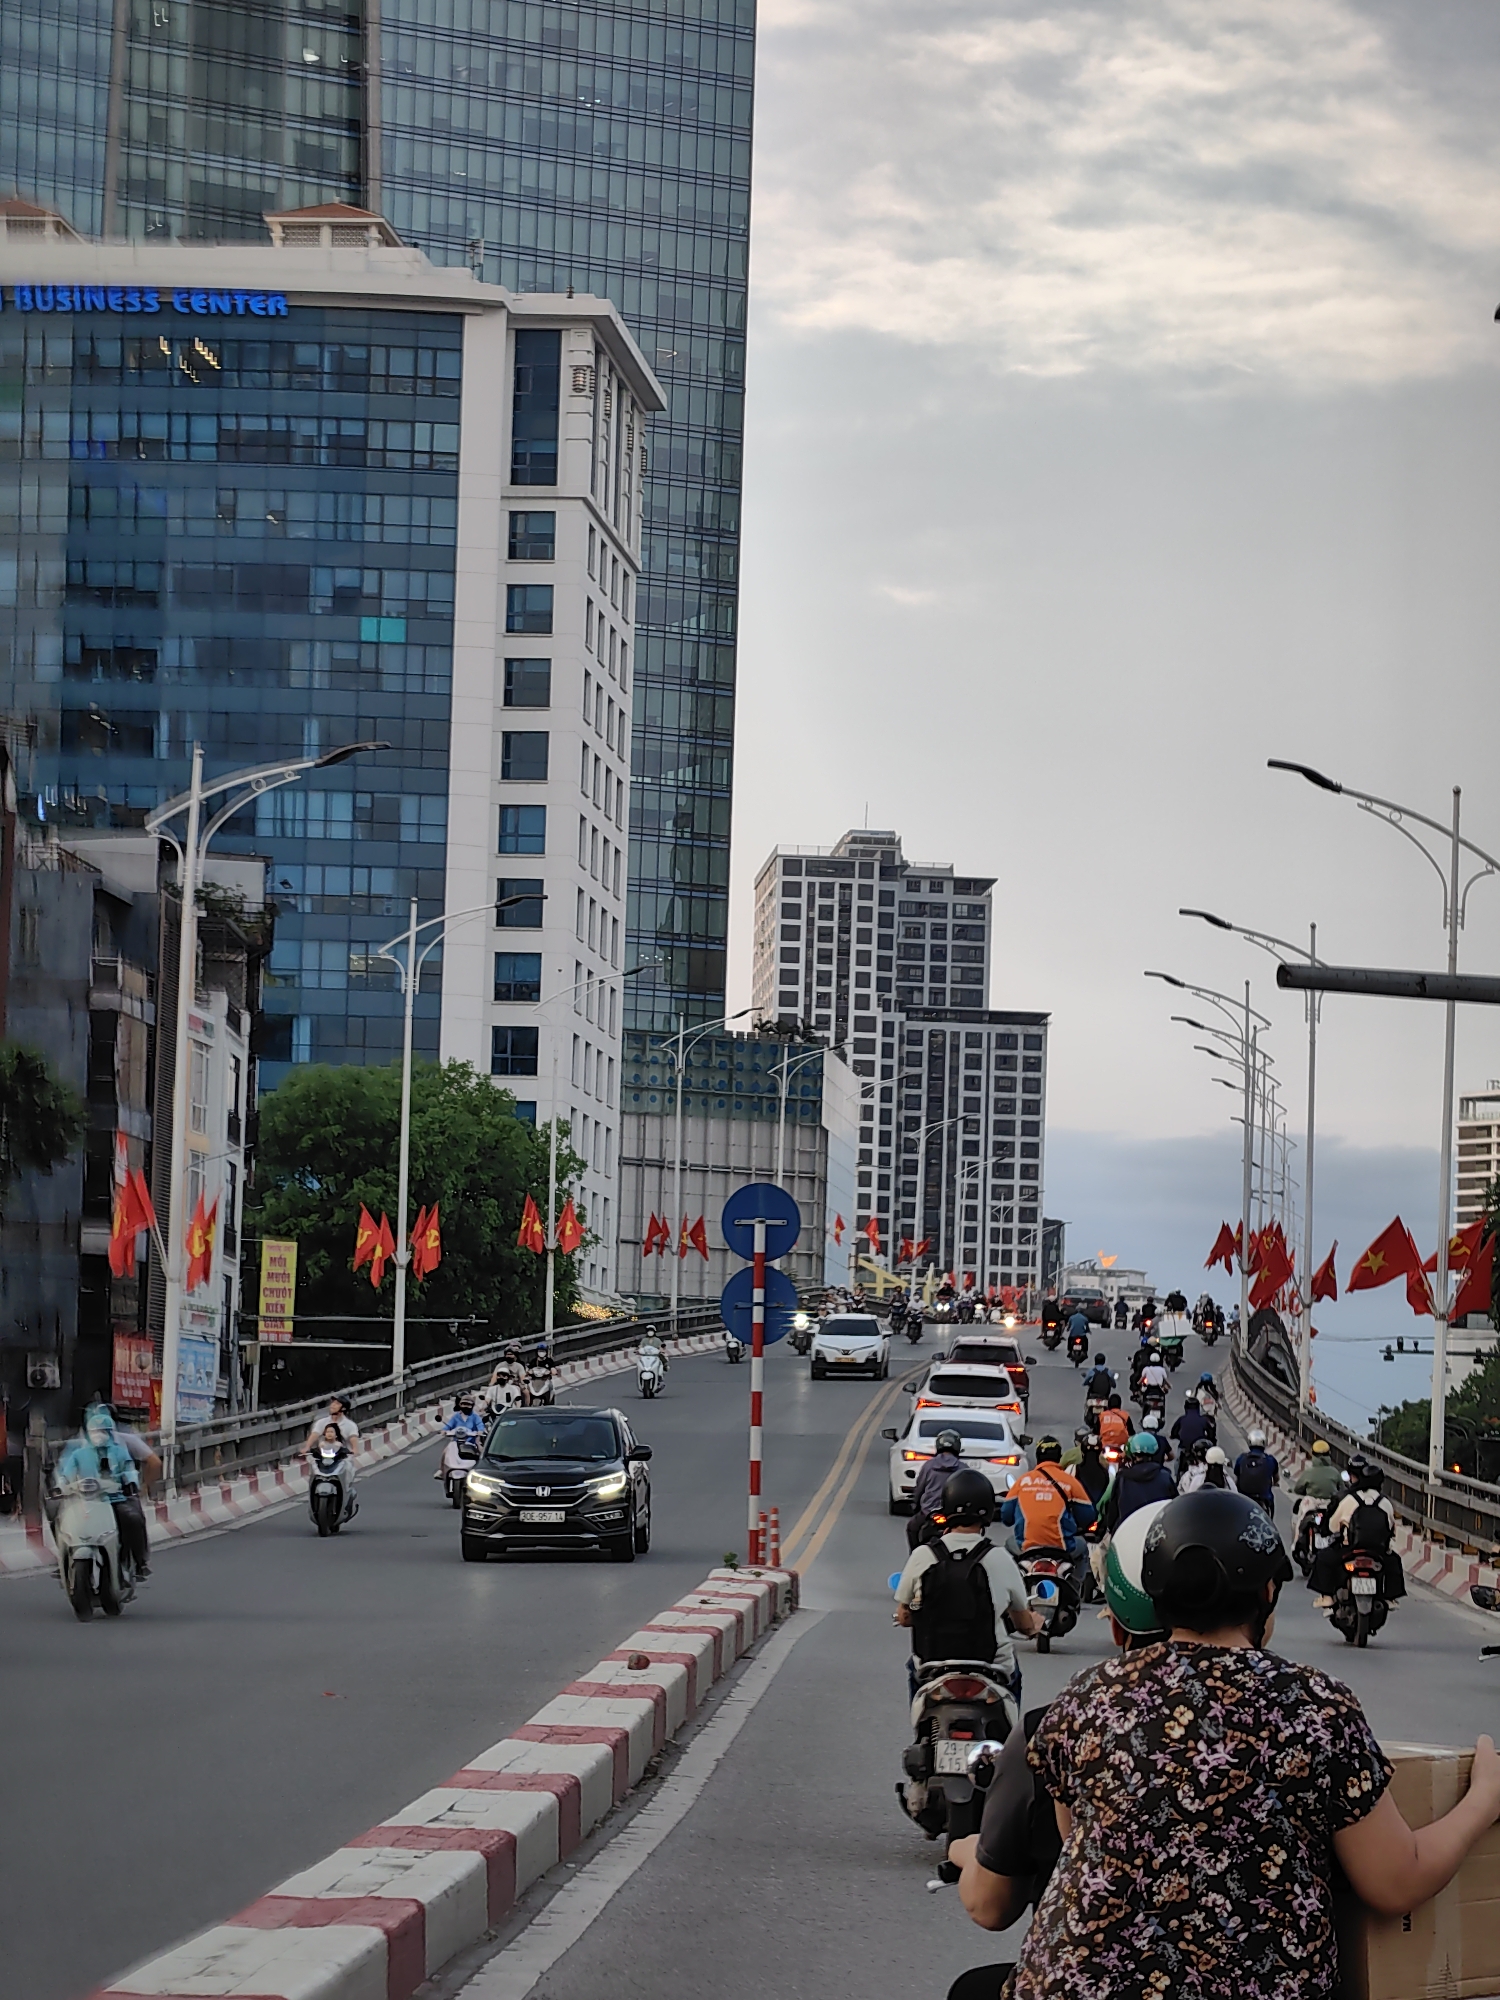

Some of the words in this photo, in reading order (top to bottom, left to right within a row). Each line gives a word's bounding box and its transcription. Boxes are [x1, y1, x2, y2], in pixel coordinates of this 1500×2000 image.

[14, 284, 161, 312] BUSINESS
[172, 290, 289, 316] CENTER
[521, 1512, 564, 1521] 30E-957.14
